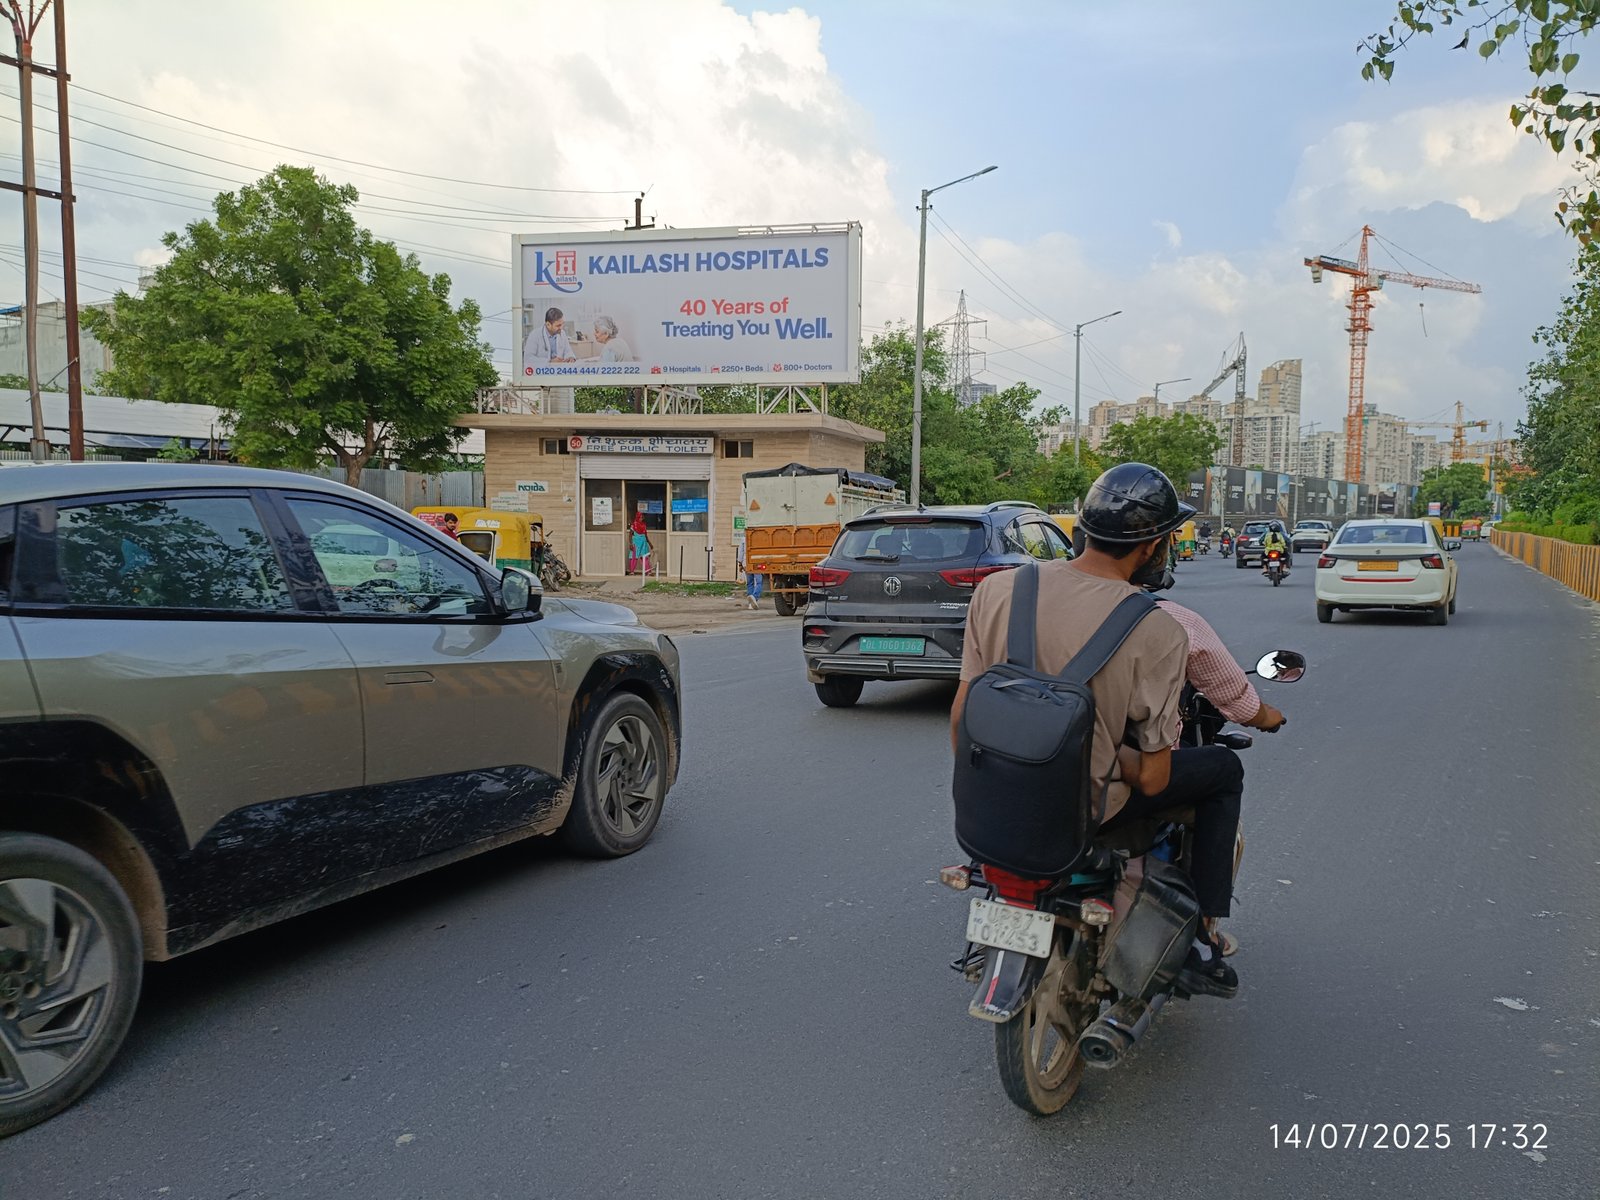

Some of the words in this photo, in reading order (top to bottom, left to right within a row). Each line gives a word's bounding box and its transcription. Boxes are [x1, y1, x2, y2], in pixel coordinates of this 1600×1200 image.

[588, 253, 690, 275] KAILASH
[696, 247, 829, 272] HOSPITALS
[680, 299, 706, 316] 40
[711, 299, 765, 316] Years
[770, 297, 790, 314] of
[661, 320, 734, 341] Treating
[737, 319, 770, 336] You
[775, 316, 833, 340] Well.
[535, 367, 555, 375] 0120
[556, 367, 578, 375] 2444
[579, 367, 600, 375] 444/
[601, 366, 623, 375] 2222
[624, 366, 640, 375] 222
[669, 365, 701, 374] Hospitals
[721, 365, 744, 373] 2250+
[745, 364, 764, 372] Beds
[783, 364, 803, 372] 800+
[804, 363, 833, 371] Doctors
[620, 445, 660, 453] PUBLIC
[667, 445, 707, 453] TOILET
[883, 576, 902, 596] MG
